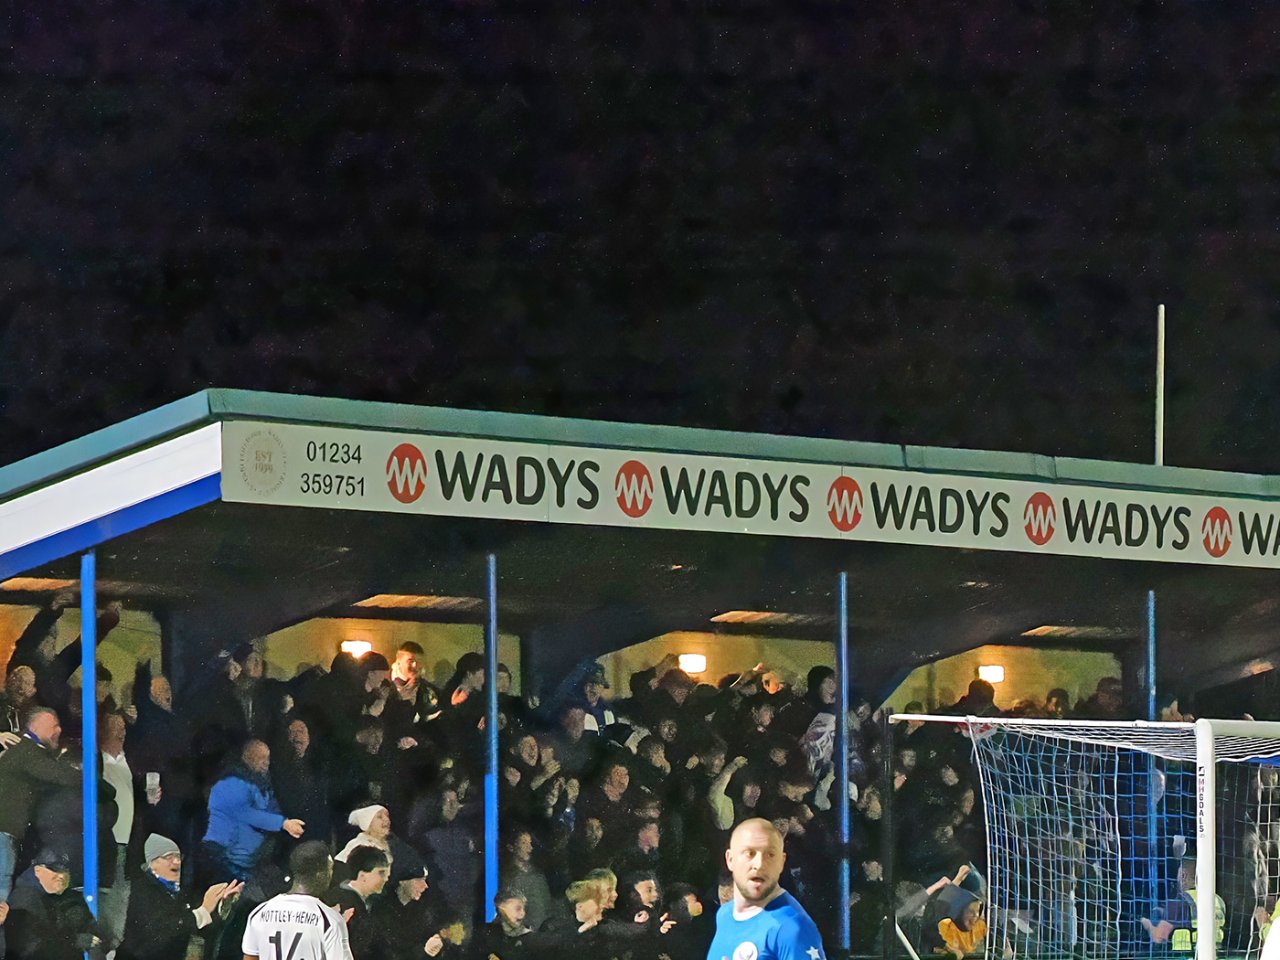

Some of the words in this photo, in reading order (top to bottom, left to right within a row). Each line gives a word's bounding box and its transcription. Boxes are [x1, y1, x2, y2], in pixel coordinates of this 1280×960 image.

[307, 441, 362, 464] 01234
[435, 449, 600, 509] WADYS
[300, 473, 365, 496] 359751
[660, 465, 811, 522] WADYS
[870, 482, 1011, 538] WADYS
[1063, 497, 1191, 550] WADYS
